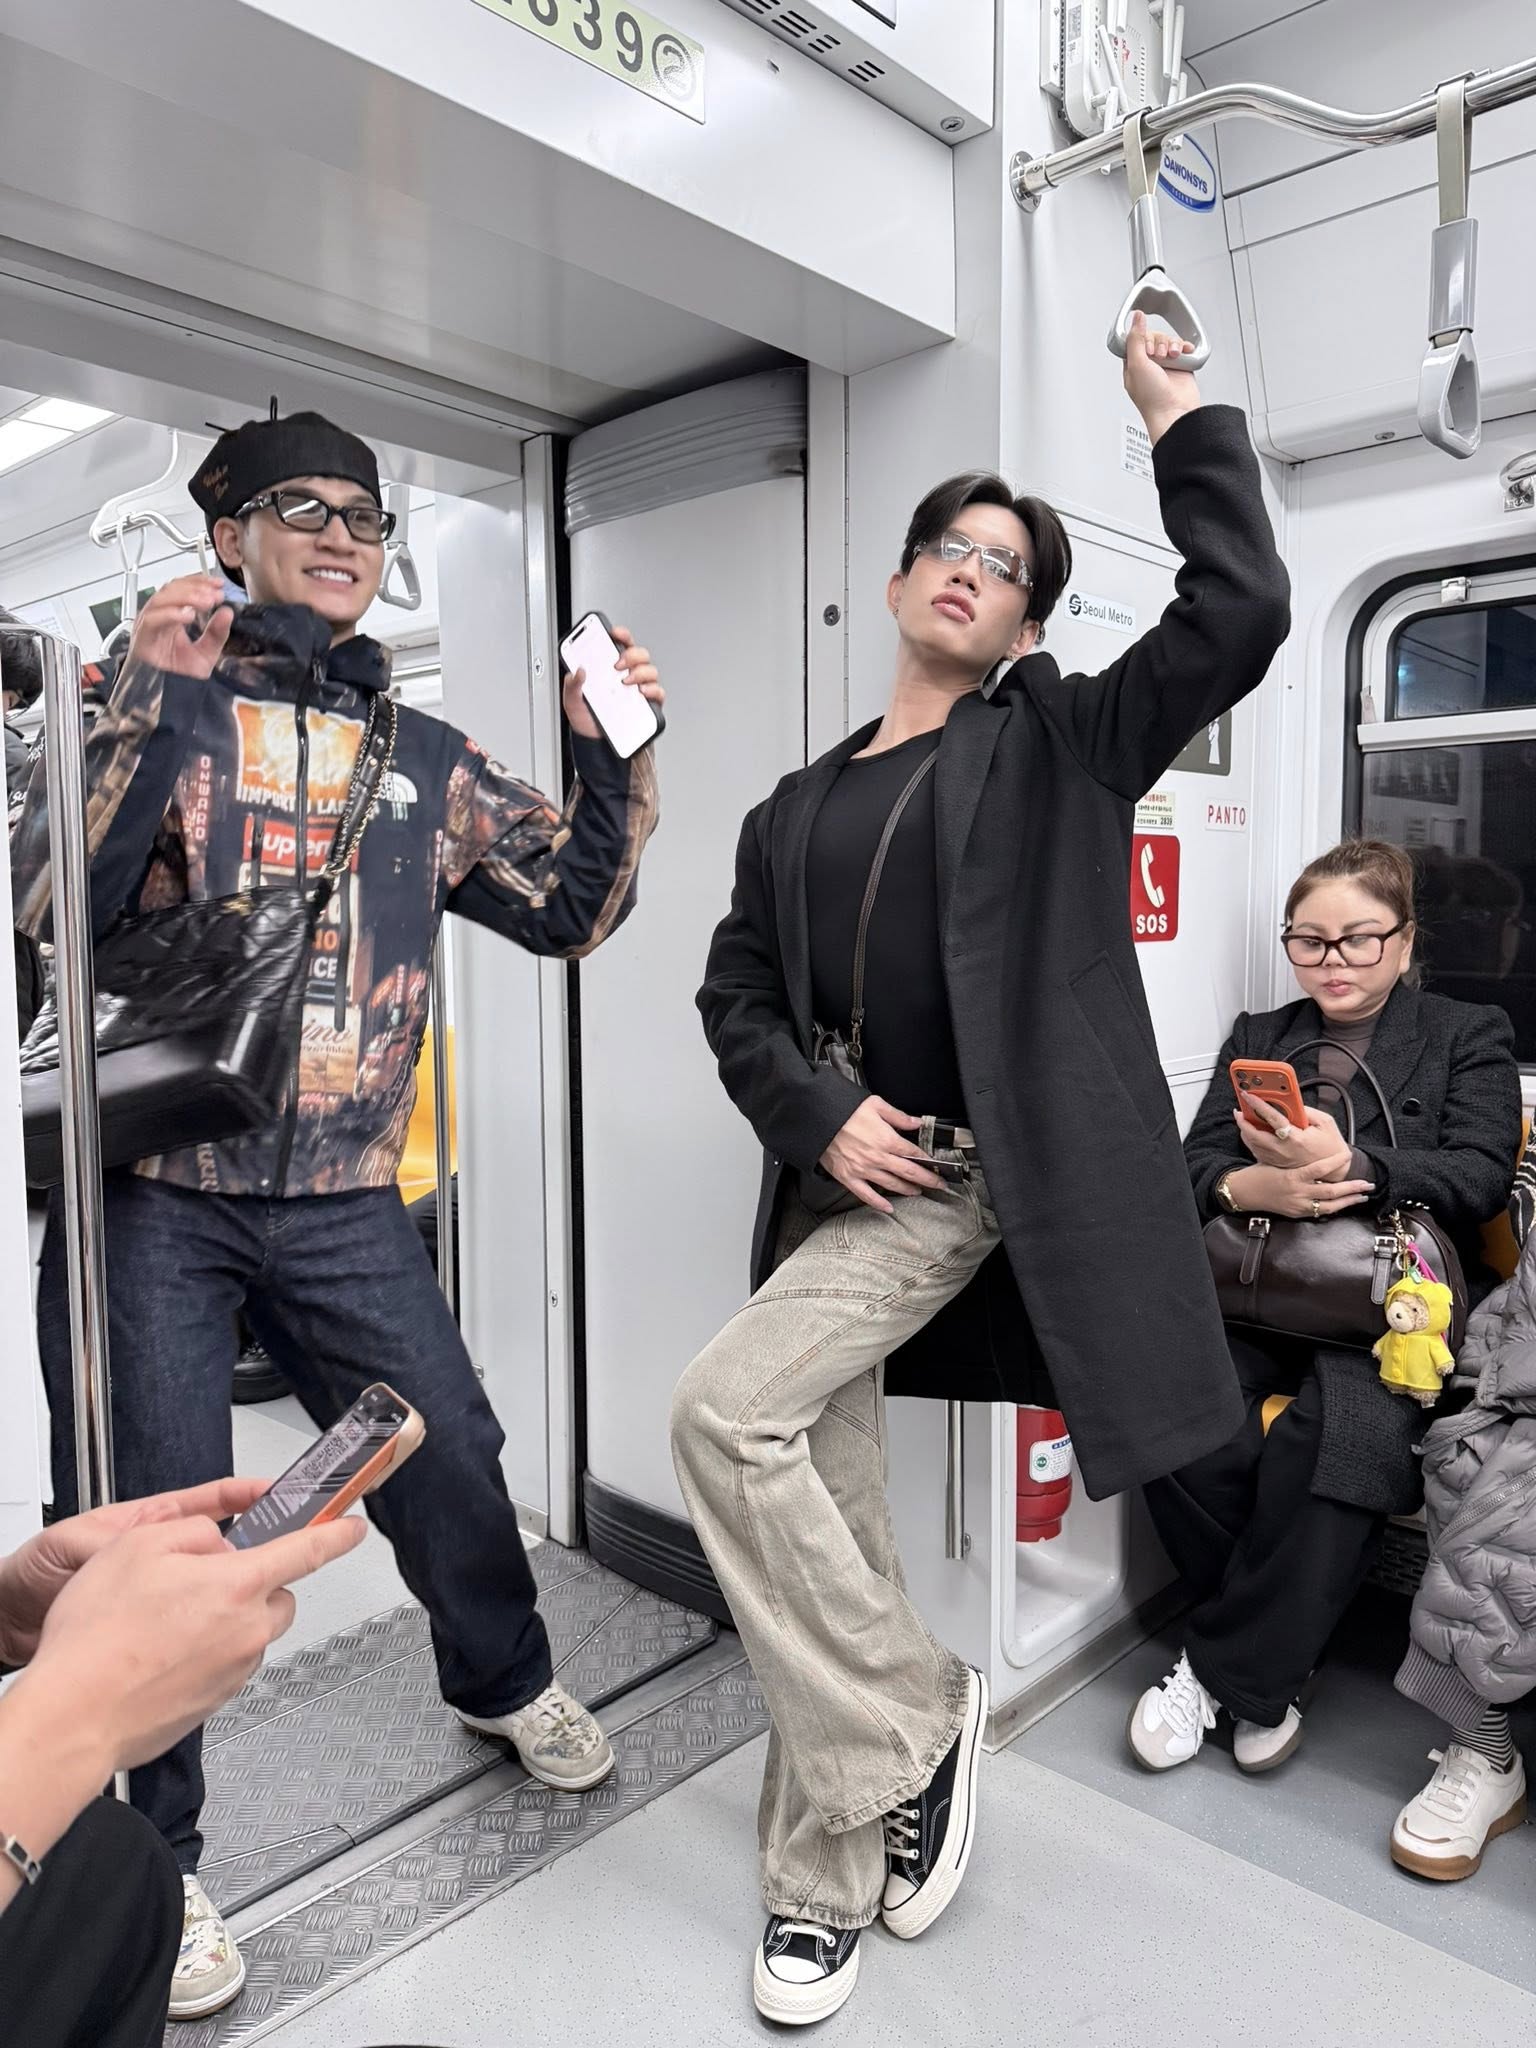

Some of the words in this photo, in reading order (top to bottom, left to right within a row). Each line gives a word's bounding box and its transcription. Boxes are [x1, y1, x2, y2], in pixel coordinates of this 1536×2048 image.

[499, 0, 643, 72] 39
[1163, 153, 1208, 194] DAWONSYS
[1083, 600, 1106, 619] Seoul
[1108, 607, 1133, 626] Metro
[195, 755, 211, 840] ONWARD
[1207, 805, 1246, 826] PANTO
[1136, 913, 1168, 935] SOS
